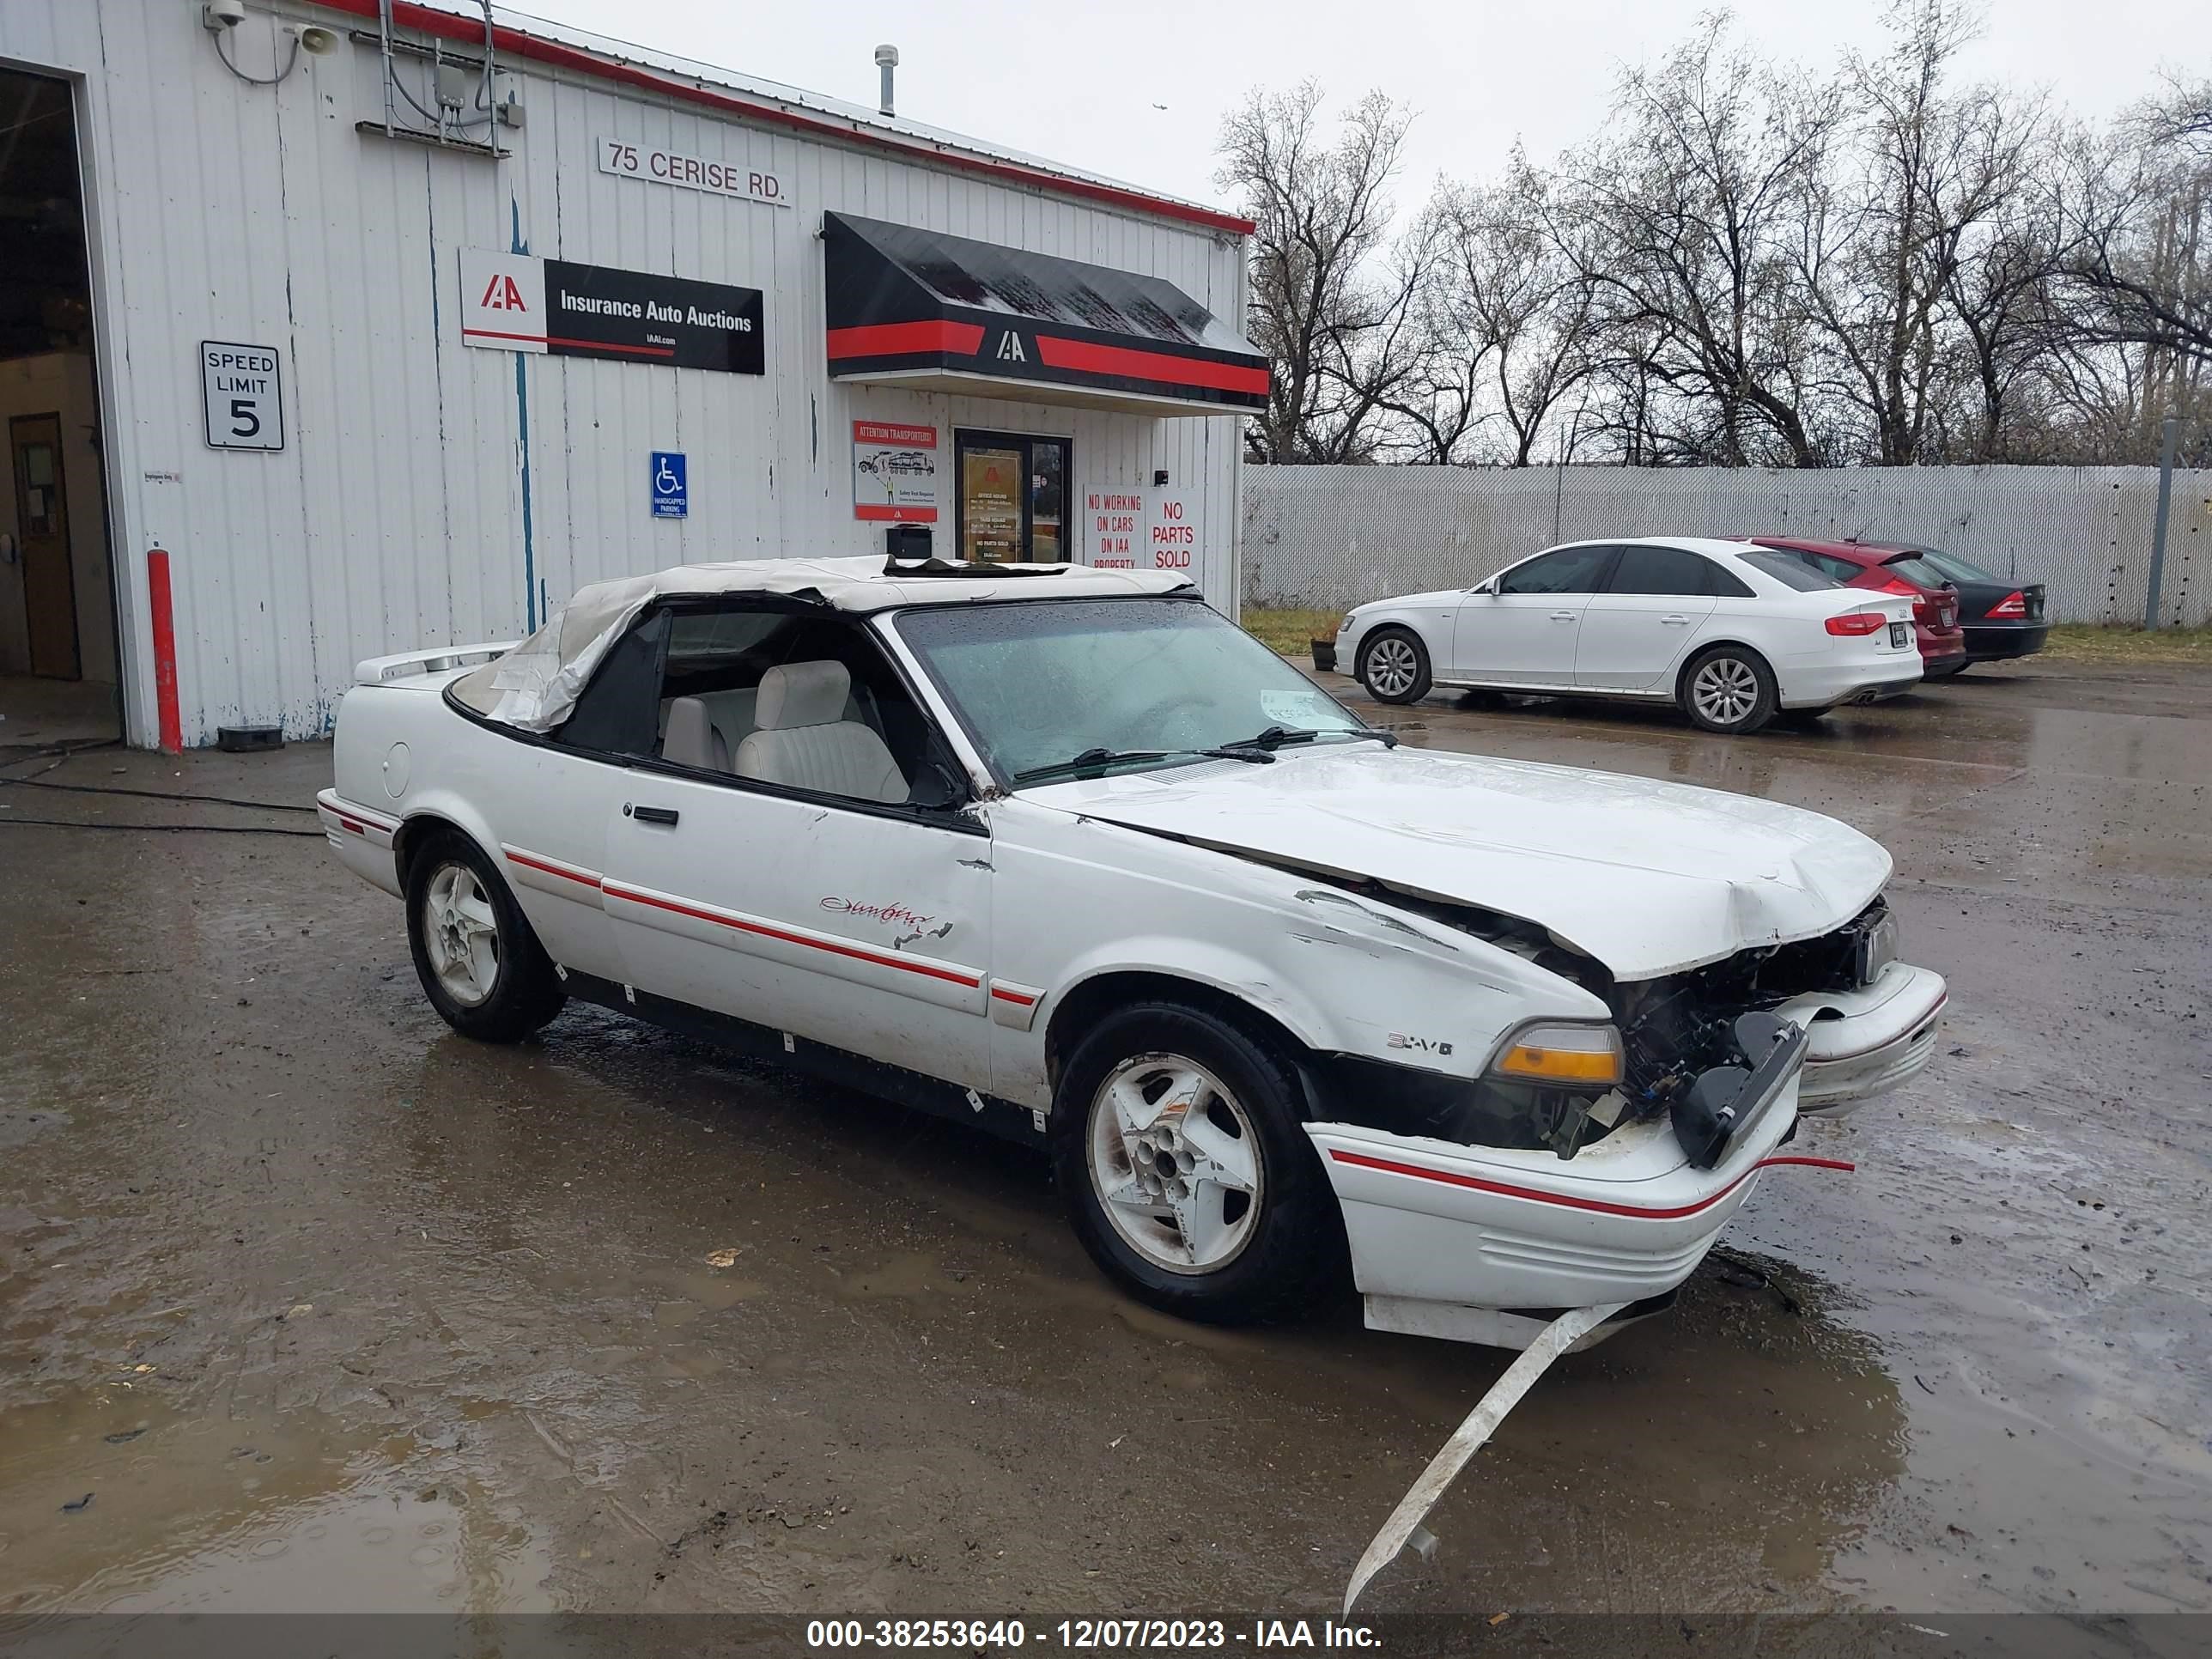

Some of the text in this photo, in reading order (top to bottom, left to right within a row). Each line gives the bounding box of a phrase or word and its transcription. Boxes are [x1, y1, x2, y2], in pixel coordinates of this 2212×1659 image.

[609, 143, 785, 201] 75 CERISE RD.
[561, 289, 752, 332] Insurance Auto Auctions
[647, 333, 677, 345] IAAI.com
[208, 352, 273, 372] SPEED
[216, 375, 267, 394] LIMIT
[231, 399, 260, 437] 5
[860, 426, 932, 442] ATTENTION TRANSPORTERS!
[1088, 494, 1141, 511] NO WORKING
[1164, 501, 1182, 520] NO
[1097, 515, 1133, 532] ON CARS
[1152, 526, 1194, 544] PARTS
[1101, 538, 1129, 554] ON IAA
[1155, 550, 1190, 568] SOLD
